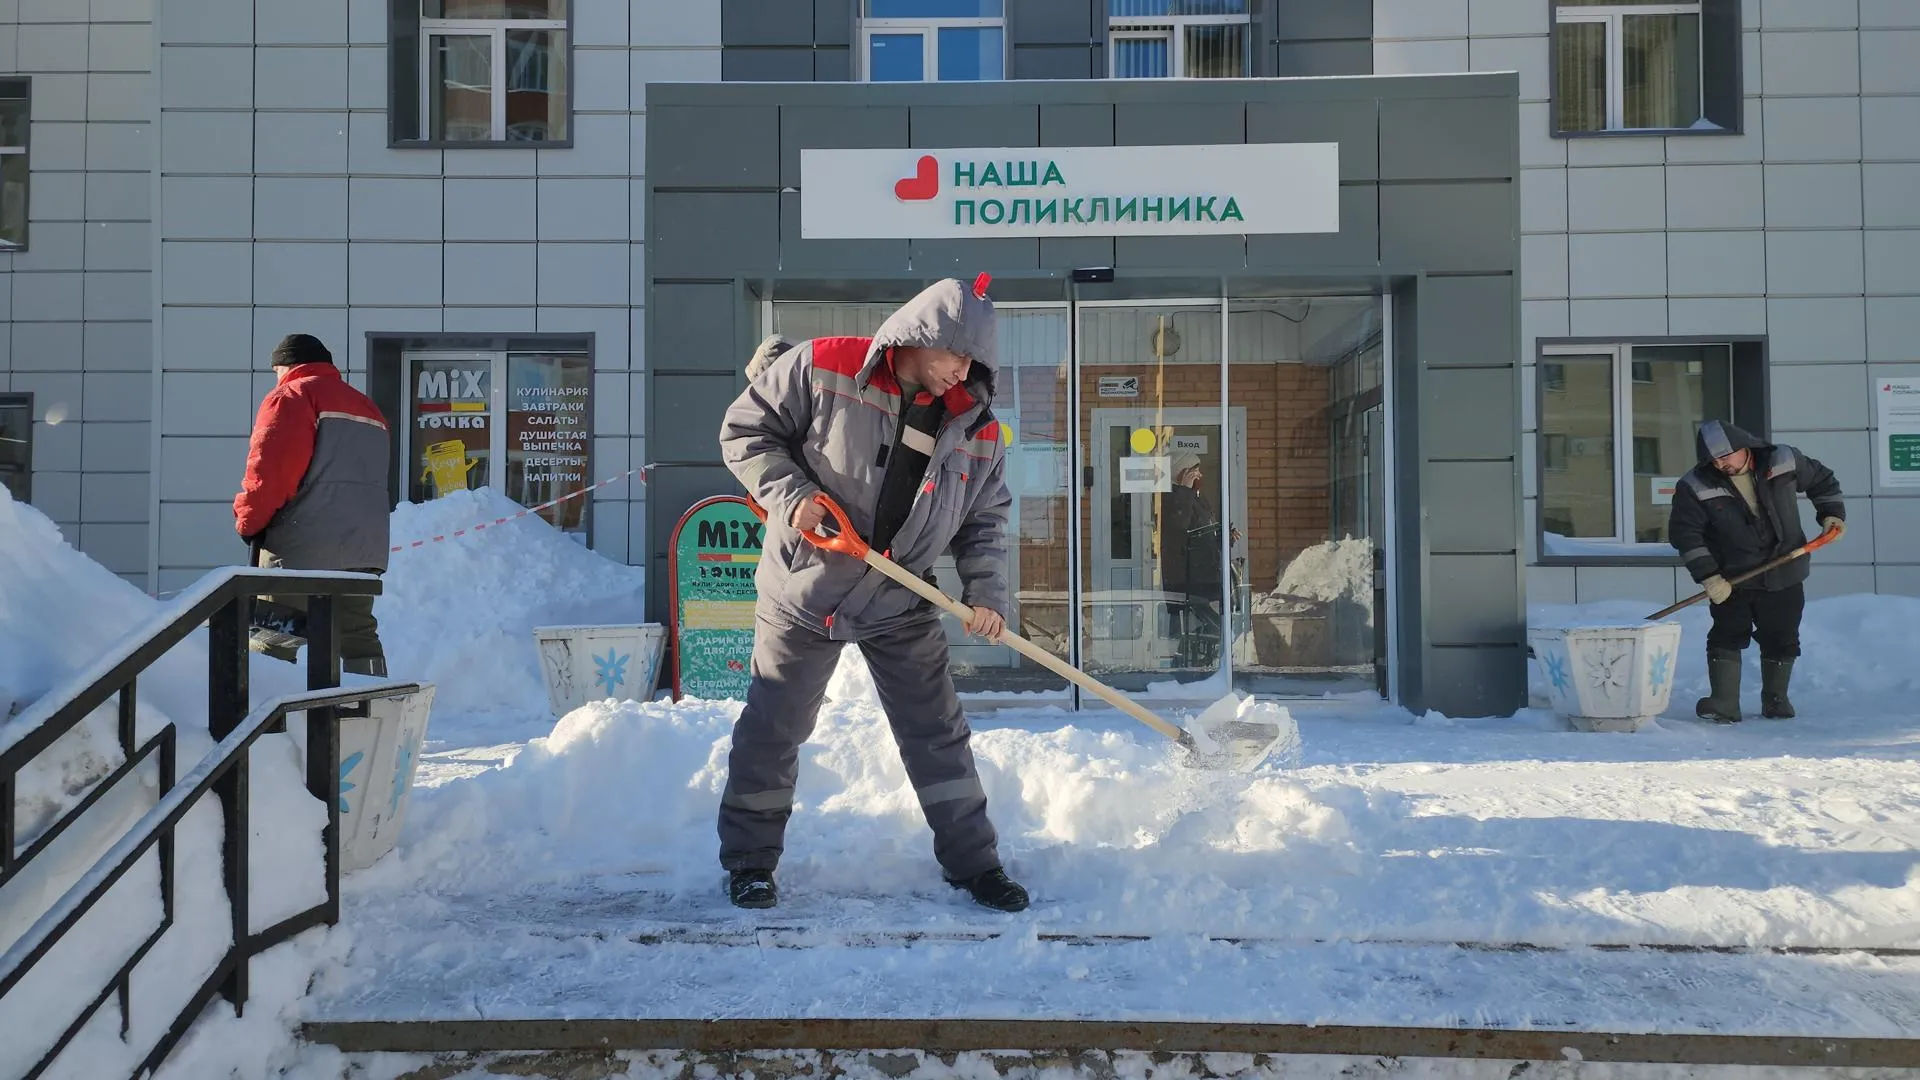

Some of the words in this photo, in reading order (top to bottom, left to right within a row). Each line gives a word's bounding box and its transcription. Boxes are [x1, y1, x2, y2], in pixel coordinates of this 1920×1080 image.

[954, 161, 1066, 187] НАША
[954, 196, 1244, 225] ПОЛИКЛИНИКА
[417, 369, 485, 399] MiX
[517, 387, 588, 397] КУЛИНАРИЯ
[522, 402, 584, 411] ЗАВТРАКИ
[528, 416, 578, 425] САЛАТЫ
[519, 431, 587, 441] ДУШИСТАЯ
[523, 441, 582, 451] ВЫПЕЧКА
[1177, 441, 1200, 449] Вход
[525, 457, 582, 467] ДЕСЕРТЫ
[524, 473, 581, 482] НАПИТКИ
[696, 637, 734, 645] ДАРИМ
[704, 647, 725, 655] ДЛЯ
